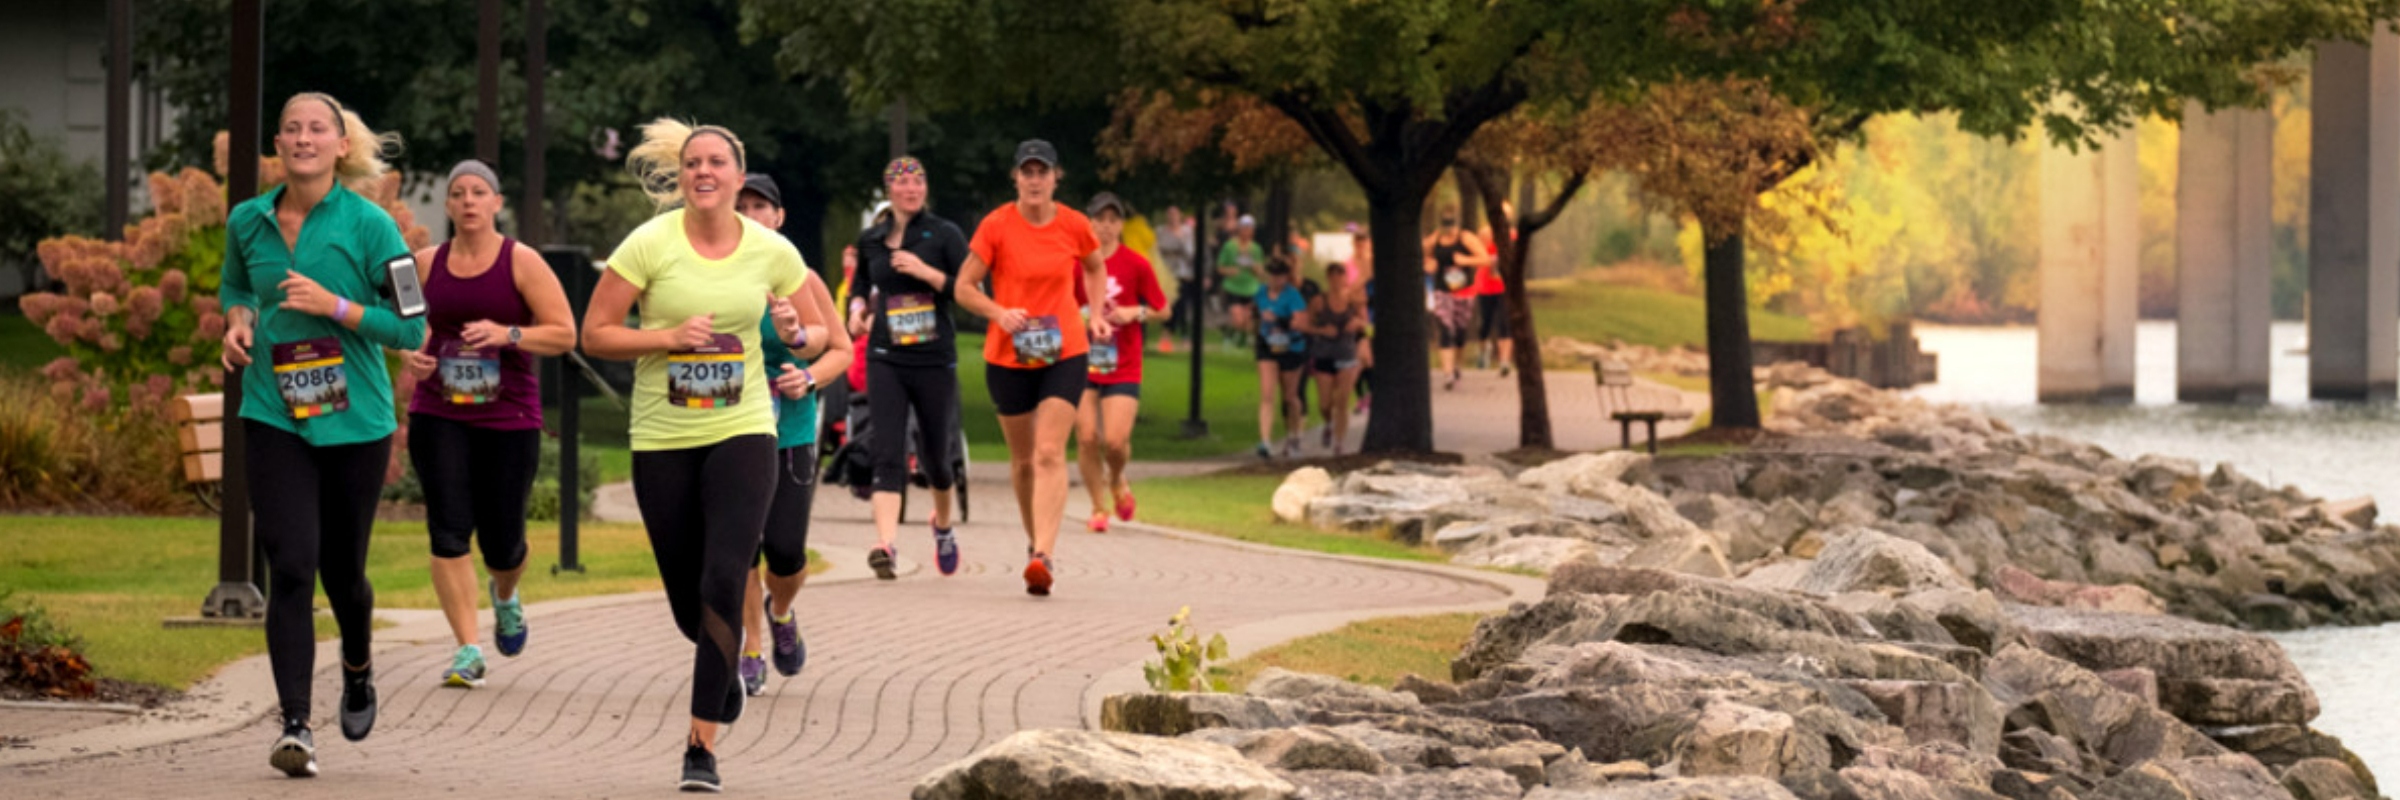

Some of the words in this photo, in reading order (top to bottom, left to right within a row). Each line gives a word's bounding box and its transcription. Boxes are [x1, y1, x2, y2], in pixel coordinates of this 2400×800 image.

[281, 367, 337, 390] 2086
[454, 365, 483, 380] 351
[681, 363, 733, 381] 2019
